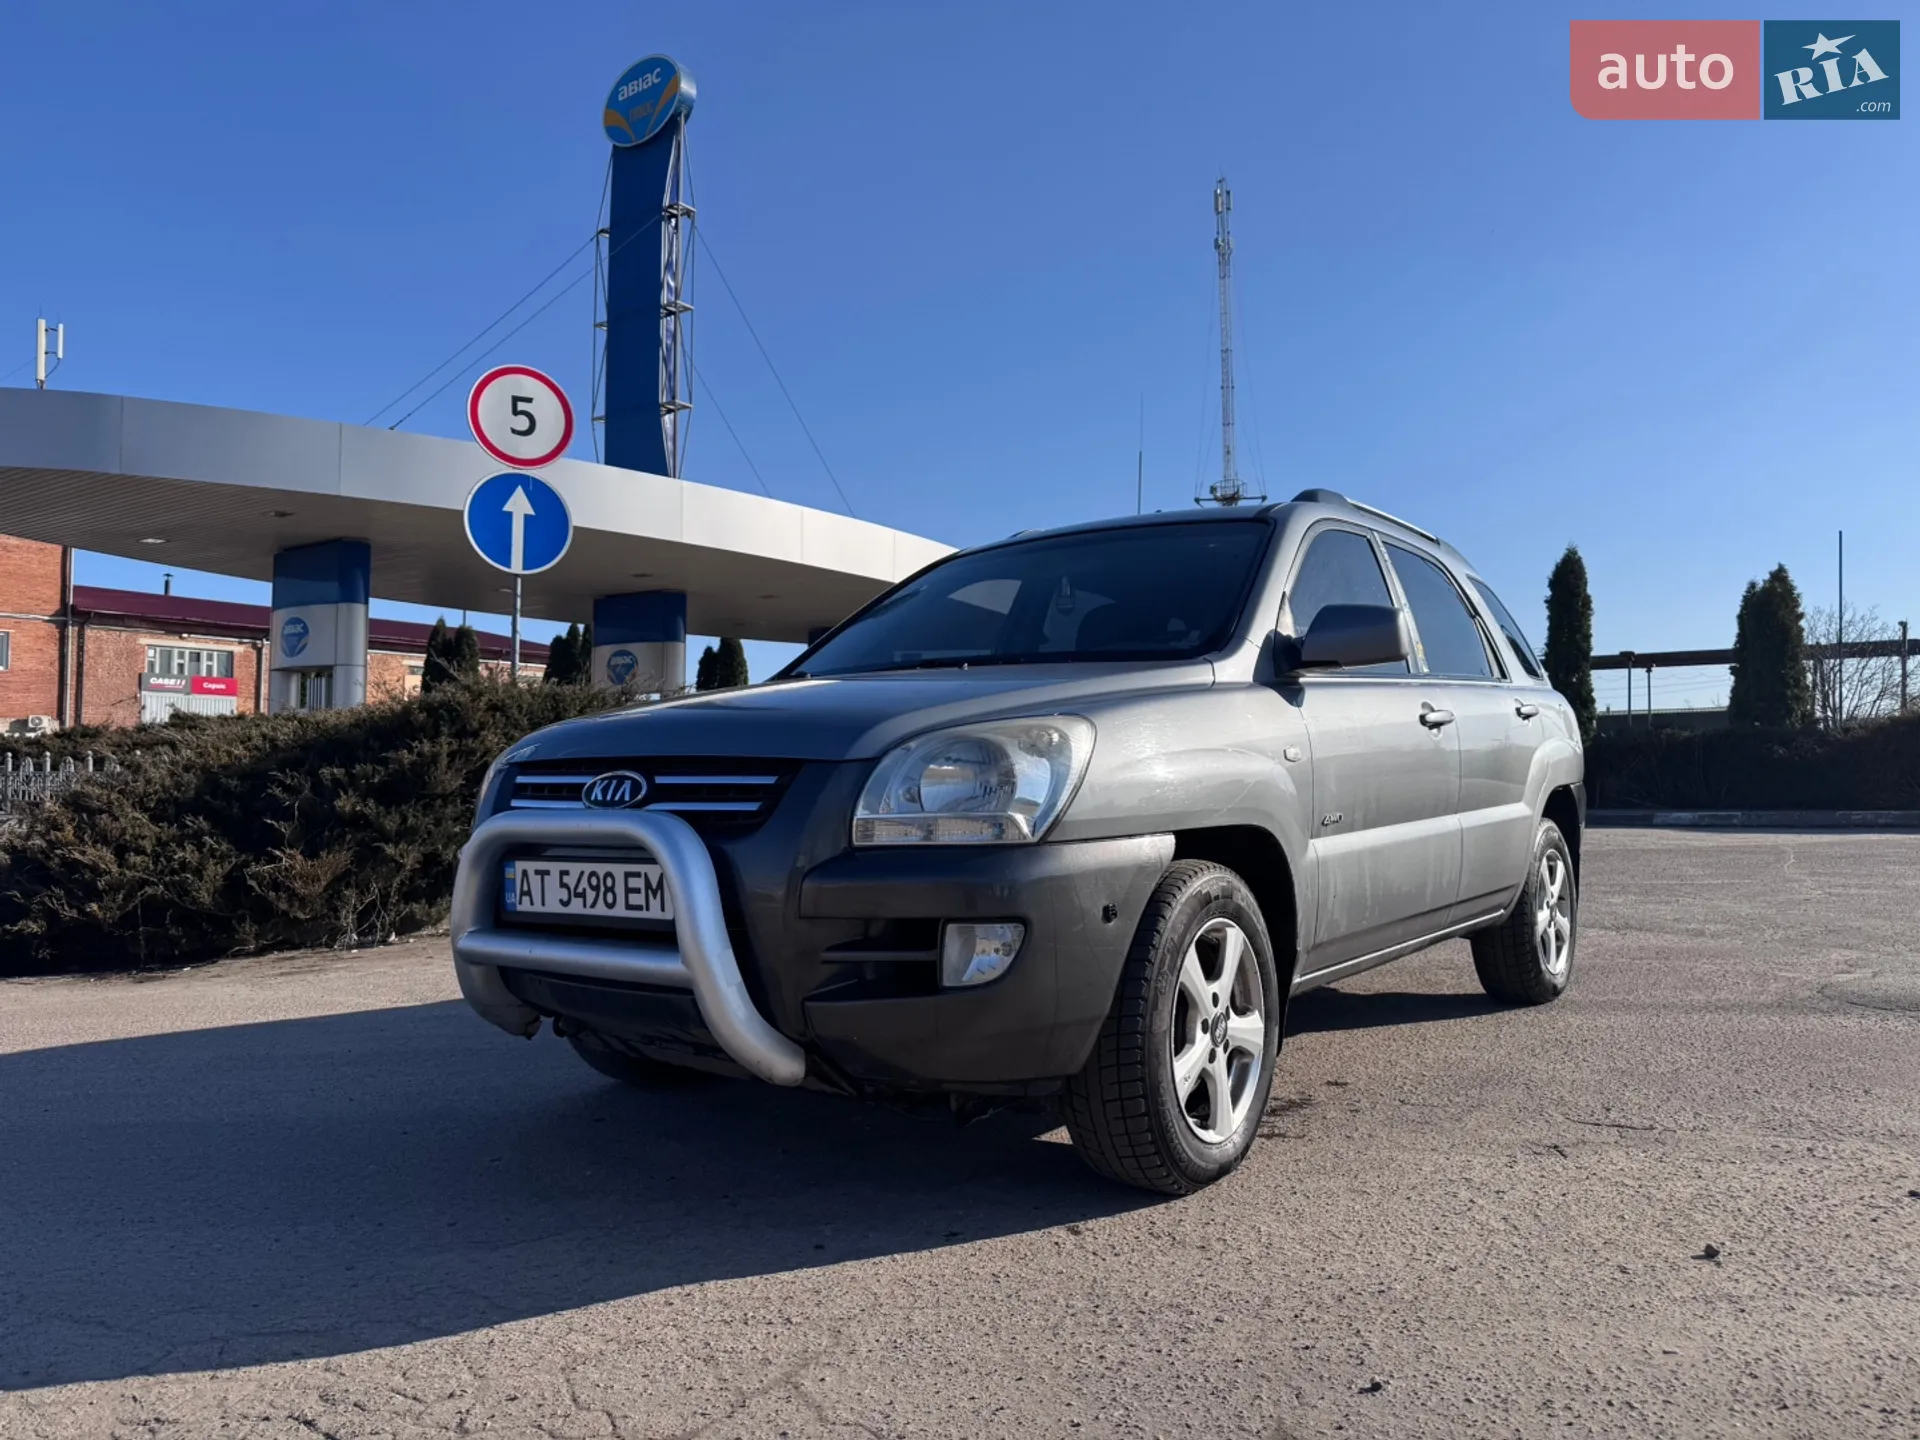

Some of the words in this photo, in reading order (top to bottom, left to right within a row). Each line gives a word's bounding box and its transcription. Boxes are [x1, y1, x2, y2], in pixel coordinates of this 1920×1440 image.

[511, 394, 537, 437] 5
[590, 780, 632, 801] KIA
[518, 868, 551, 907] AT
[558, 870, 617, 909] 5498
[623, 871, 666, 913] EM
